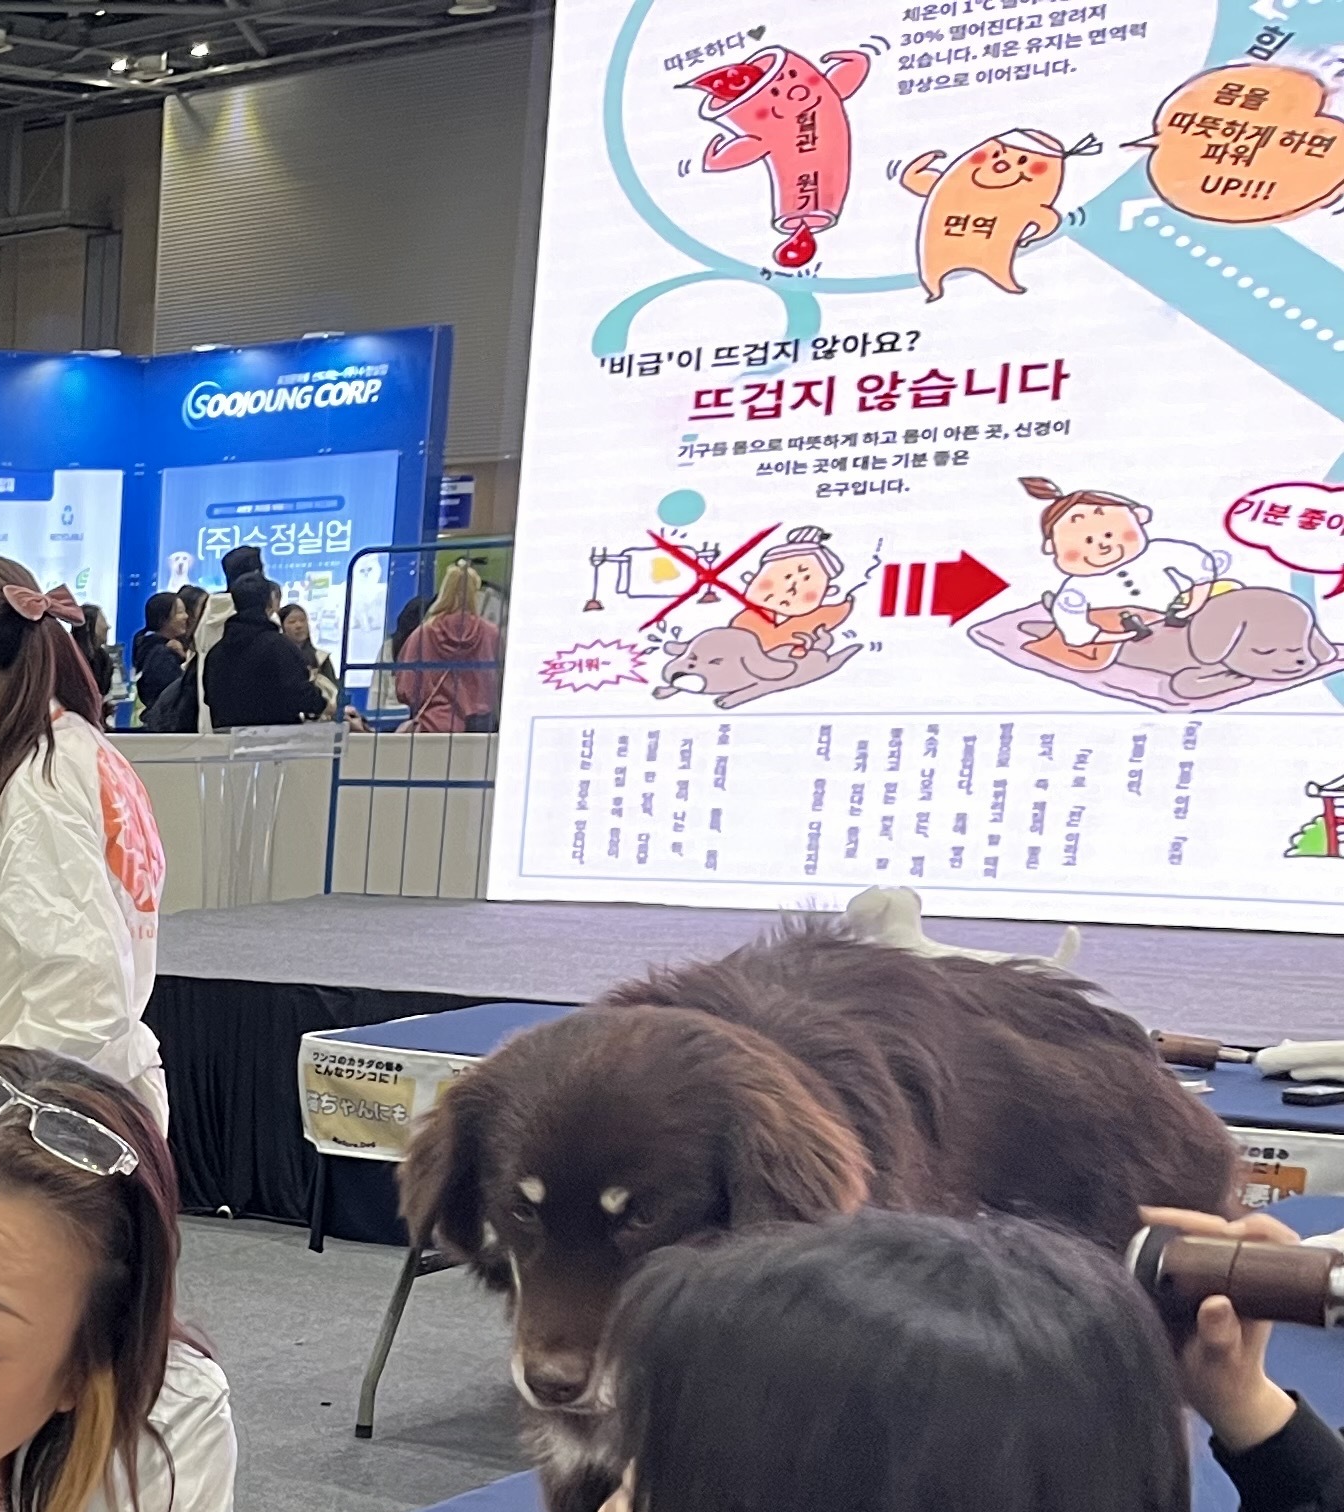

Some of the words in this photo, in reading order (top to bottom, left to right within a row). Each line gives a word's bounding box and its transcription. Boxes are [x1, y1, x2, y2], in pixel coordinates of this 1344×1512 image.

[663, 31, 746, 71] 따뜻하다
[898, 46, 978, 72] 있습니다.
[982, 40, 1020, 59] 체온
[1026, 33, 1083, 54] 유지는
[900, 29, 945, 47] 30%
[975, 59, 1078, 85] 이어집니다.
[1213, 81, 1270, 111] 몸을
[1168, 112, 1278, 149] 따뜻하게
[1278, 129, 1337, 158] 하면
[1200, 142, 1257, 167] 파워
[1200, 174, 1277, 201] UP!!!
[944, 214, 999, 240] 면역
[709, 338, 802, 369] 뜨겁지
[811, 329, 921, 361] 않아요?
[188, 384, 314, 420] SOOJOUNG
[314, 378, 383, 409] CORP.
[688, 375, 836, 422] 뜨겁지
[856, 358, 1071, 412] 않습니다
[787, 432, 858, 452] 따뜻하게
[862, 430, 897, 447] 하고
